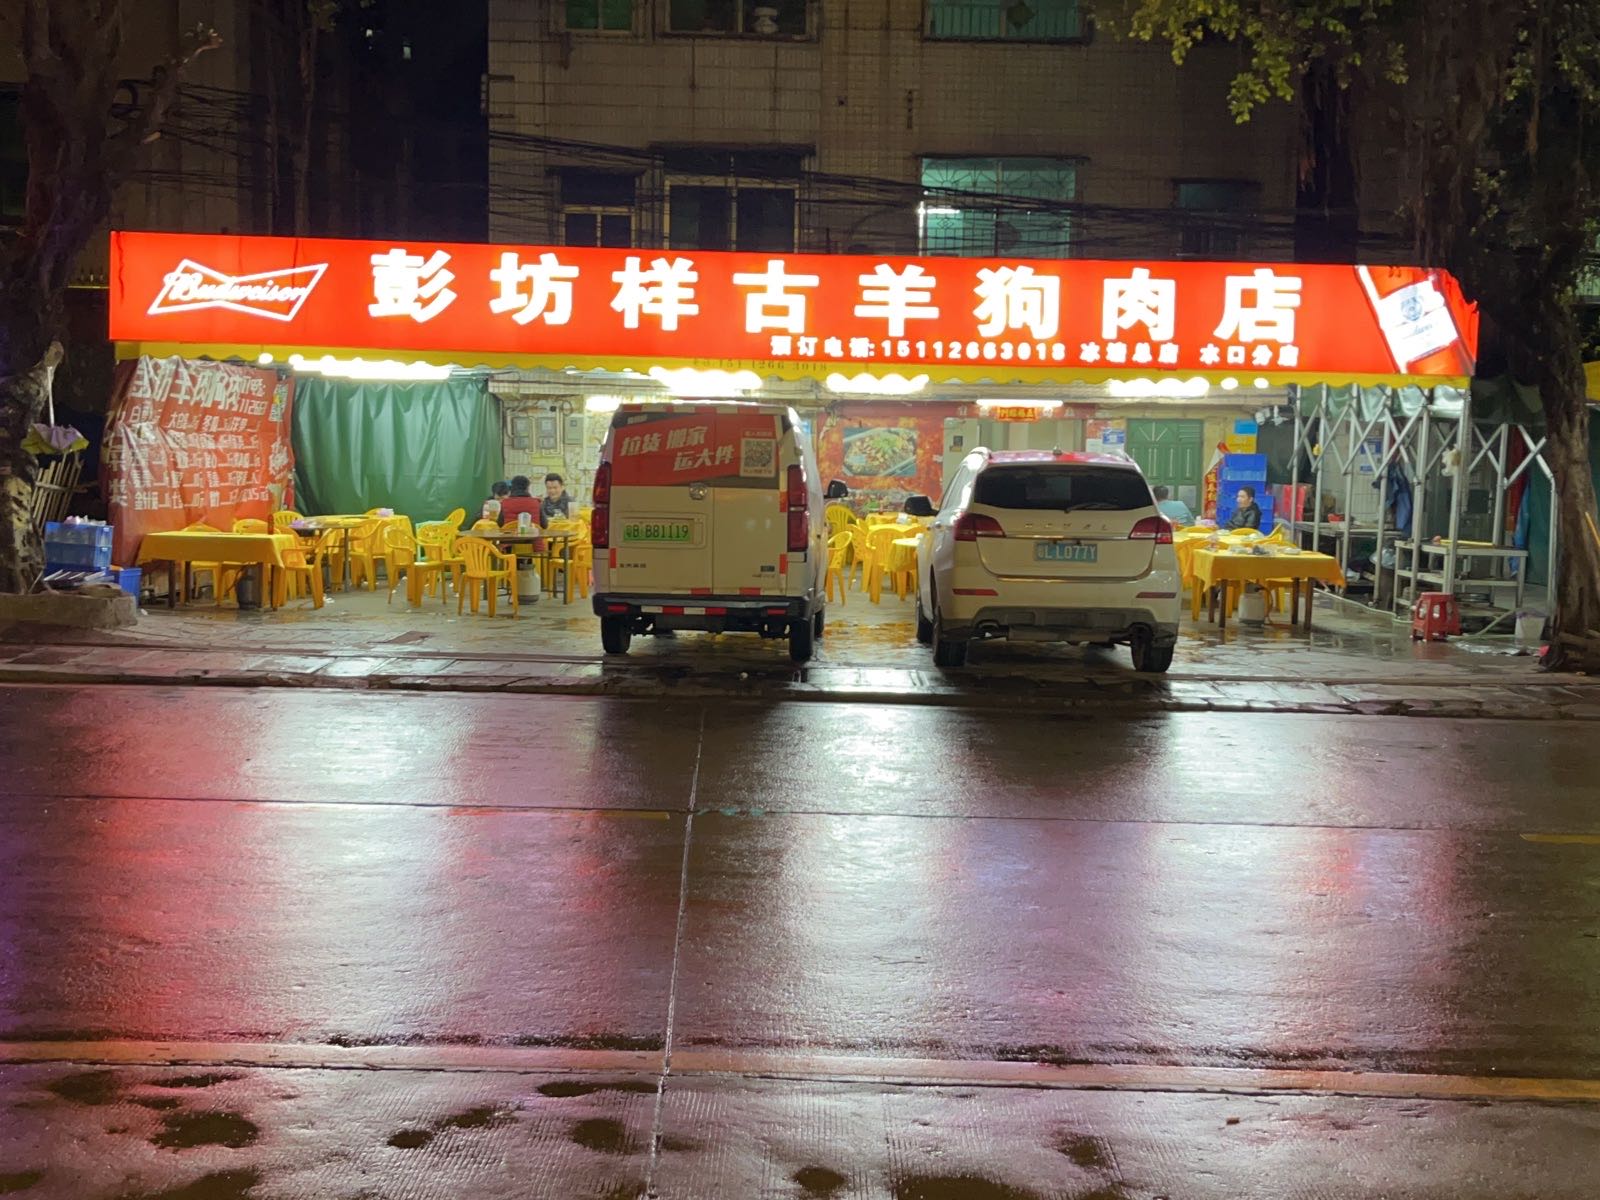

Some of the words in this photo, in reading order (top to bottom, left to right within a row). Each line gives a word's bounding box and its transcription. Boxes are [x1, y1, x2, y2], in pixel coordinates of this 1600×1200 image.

[163, 272, 307, 302] Budweiser
[368, 248, 1301, 343] 彭坊样古羊狗肉店
